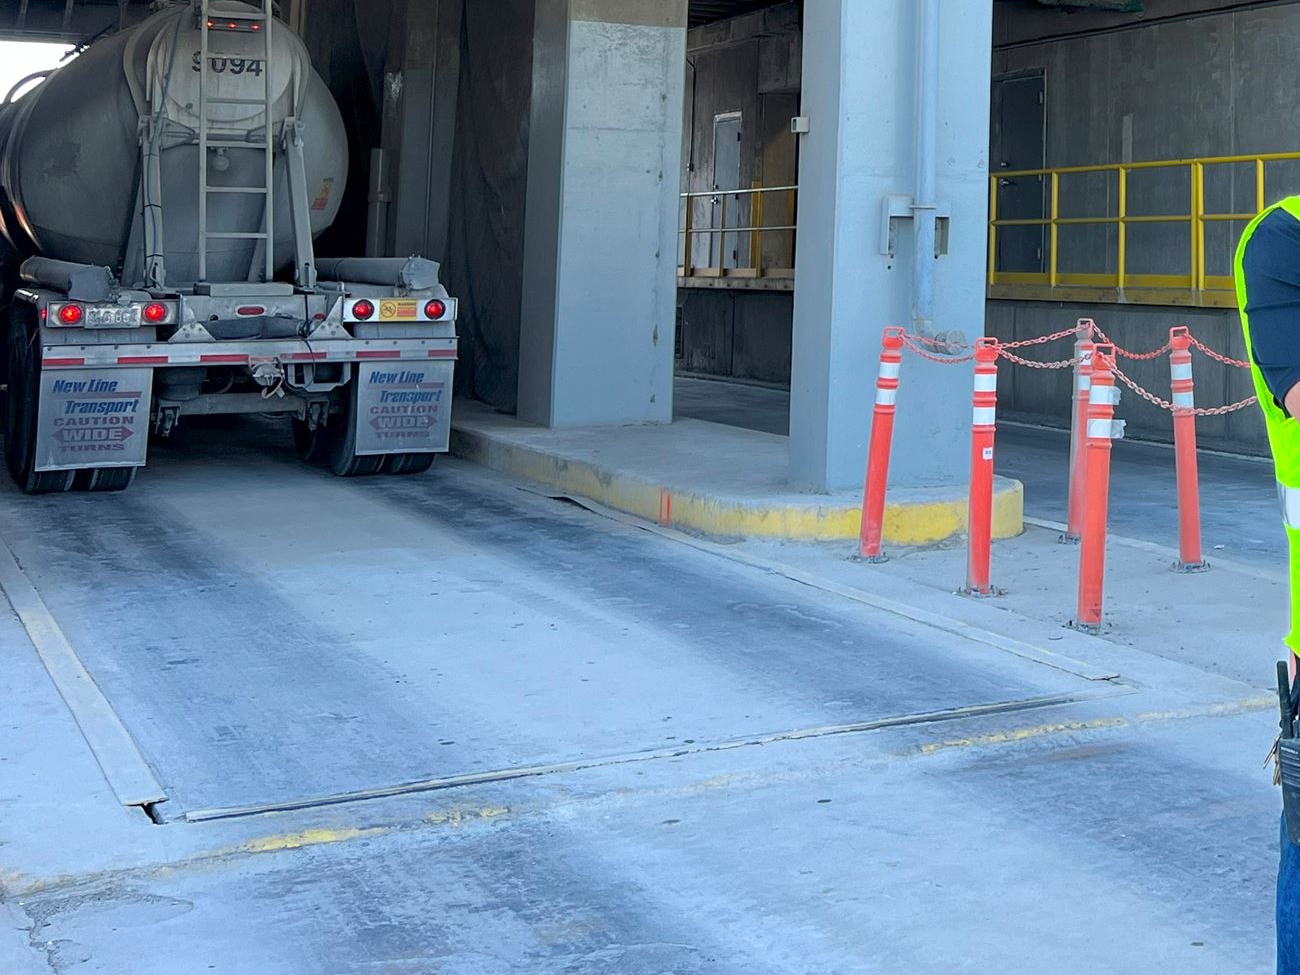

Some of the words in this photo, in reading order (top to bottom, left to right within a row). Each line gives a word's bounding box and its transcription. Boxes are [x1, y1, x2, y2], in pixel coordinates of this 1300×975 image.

[369, 371, 398, 383] New
[399, 371, 424, 383] Line
[53, 380, 86, 393] New
[88, 379, 118, 393] Line
[379, 390, 442, 403] Transport
[65, 399, 139, 415] Transport
[370, 405, 437, 414] CAUTION
[53, 416, 134, 426] CAUTION
[377, 416, 428, 428] WIDE
[62, 428, 122, 441] WIDE
[60, 443, 125, 453] TURNS
